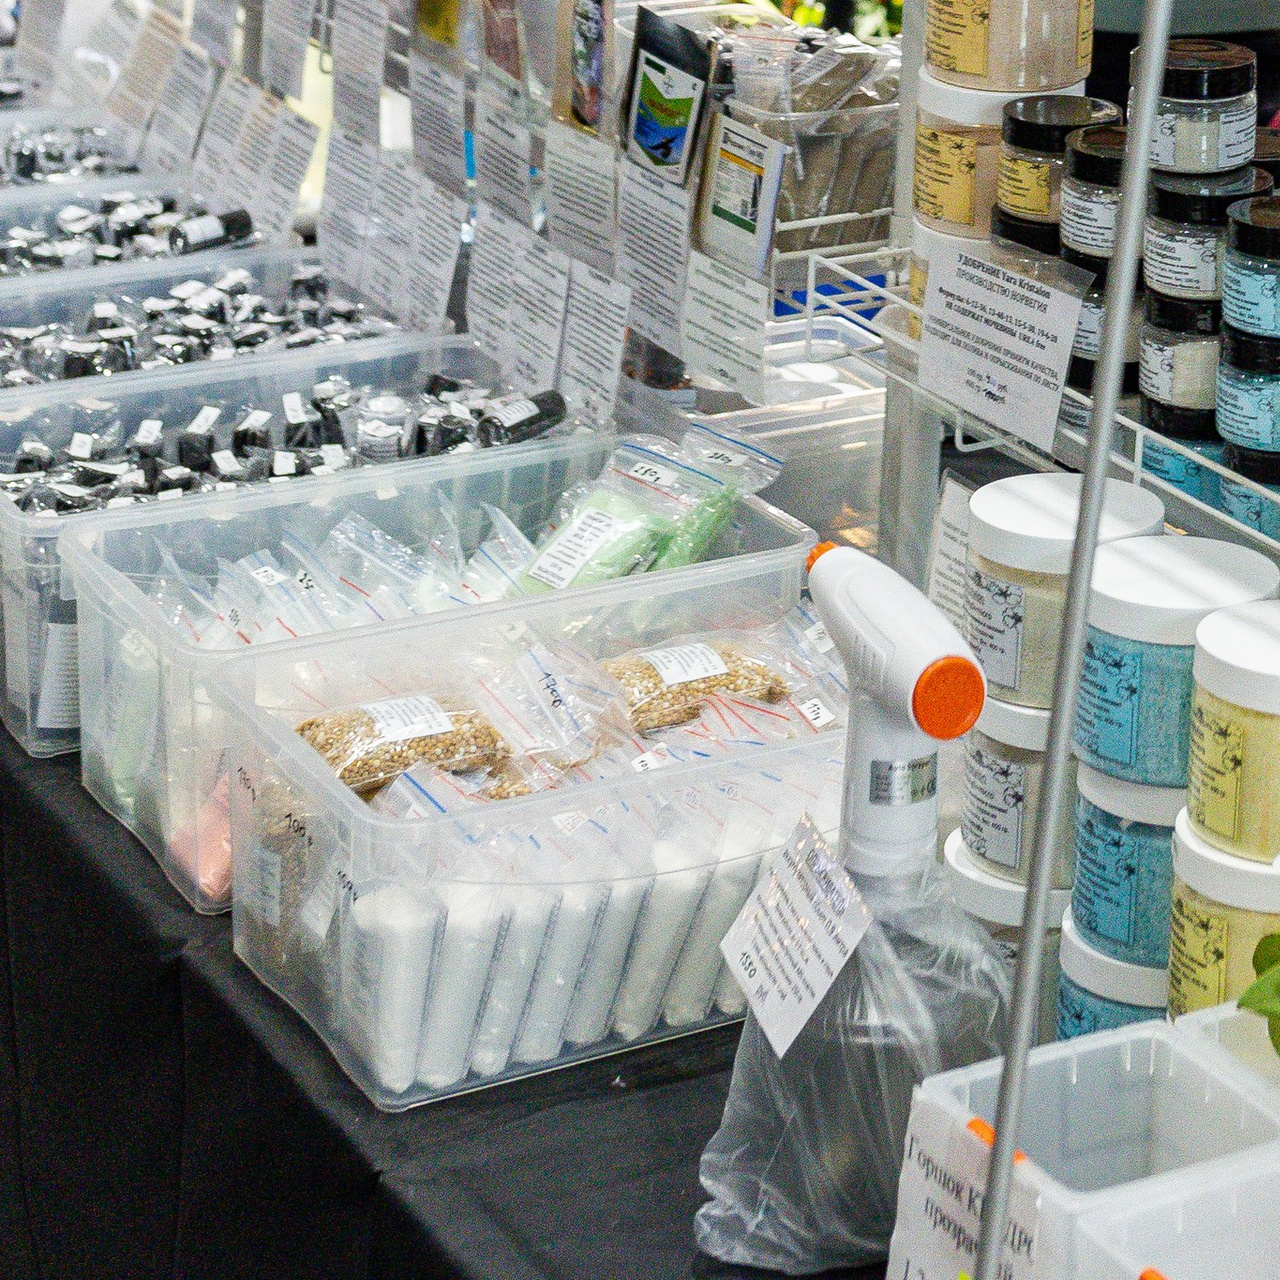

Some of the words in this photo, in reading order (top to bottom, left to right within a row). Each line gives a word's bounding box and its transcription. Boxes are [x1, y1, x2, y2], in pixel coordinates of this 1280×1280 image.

[958, 254, 1004, 279] УДОБРЕНИЕ
[1002, 272, 1022, 286] Yara
[1016, 278, 1051, 299] Kristalon
[908, 1133, 964, 1203] Горшок
